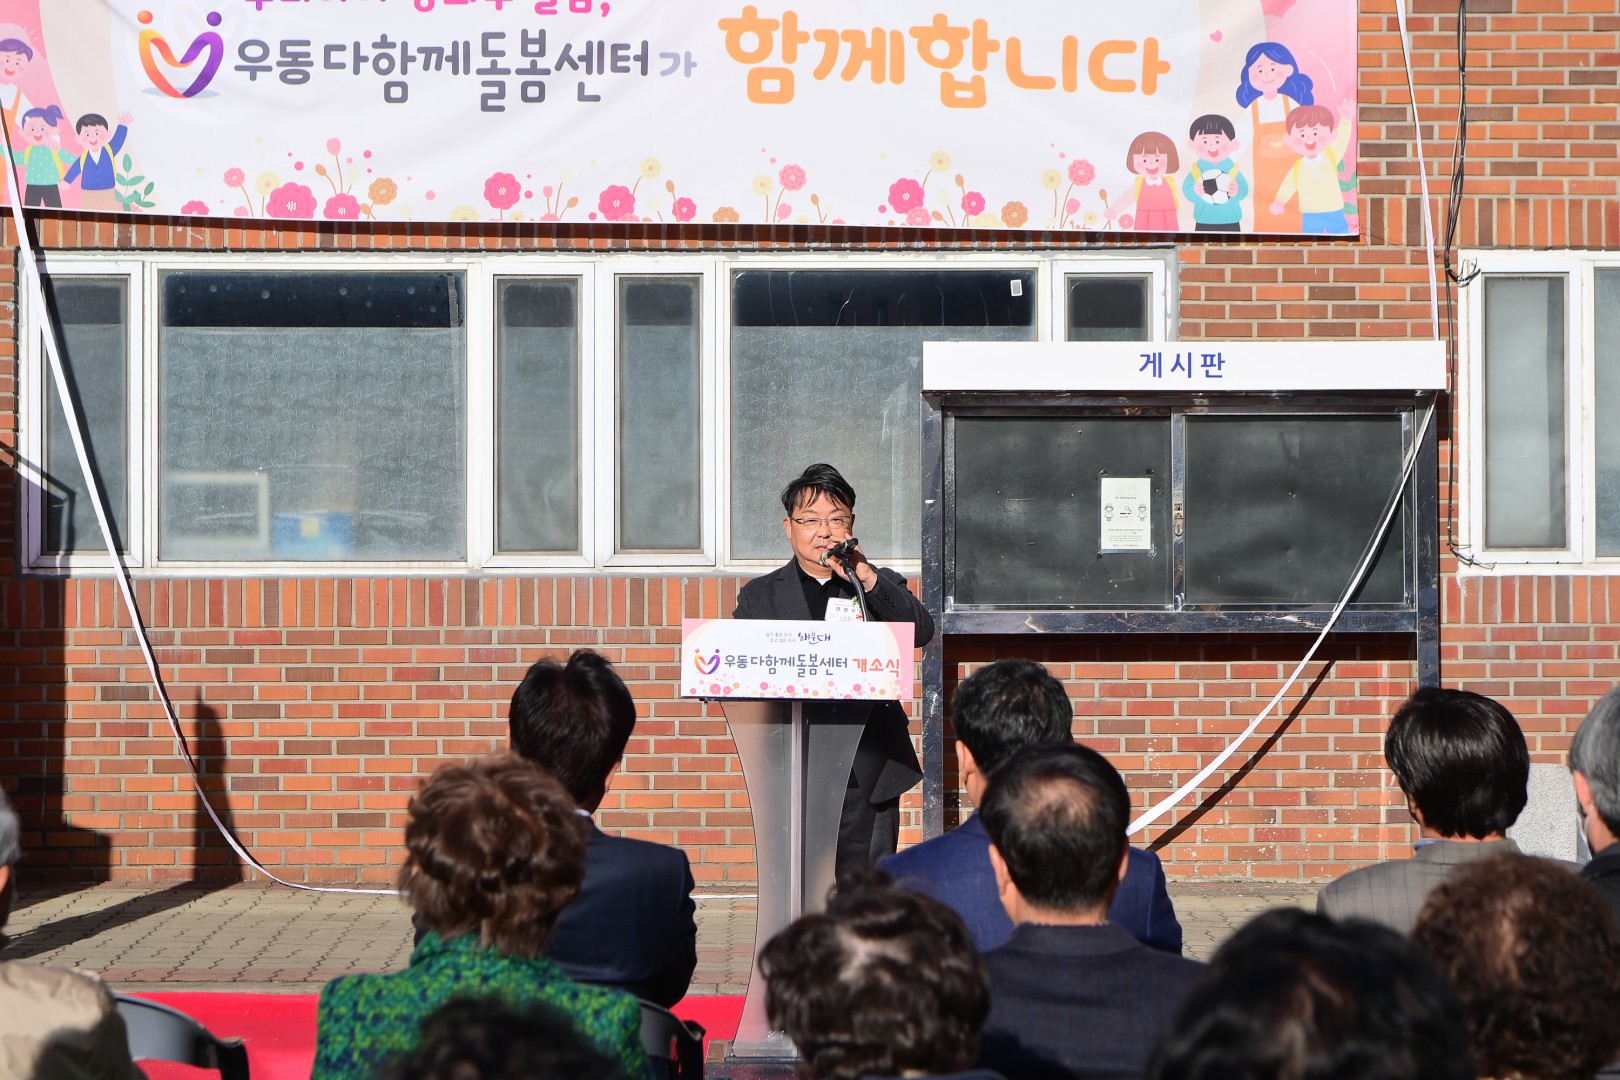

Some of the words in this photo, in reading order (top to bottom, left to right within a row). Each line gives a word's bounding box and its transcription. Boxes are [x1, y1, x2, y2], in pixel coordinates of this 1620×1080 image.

[718, 6, 1170, 108] 함께합니다
[1139, 352, 1225, 378] 게시판
[798, 631, 830, 644] 해운대
[725, 654, 847, 677] 우동다함께돌봄센터
[853, 658, 900, 678] 개소식
